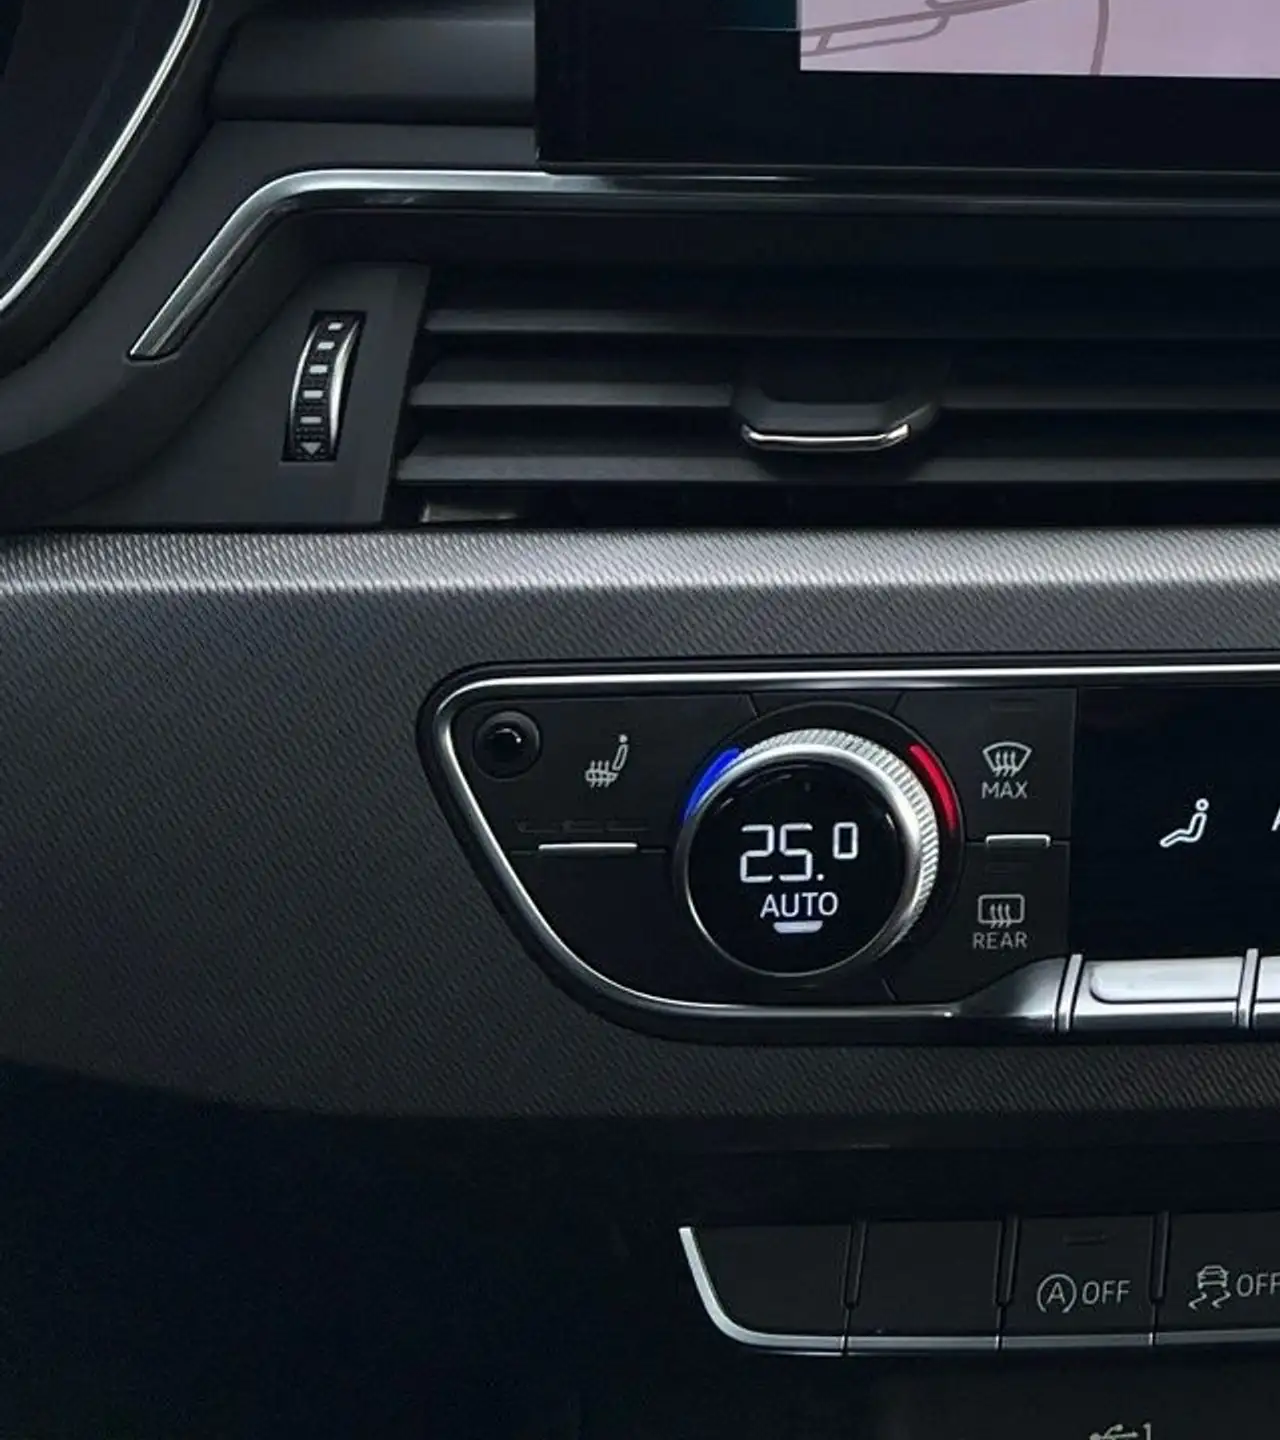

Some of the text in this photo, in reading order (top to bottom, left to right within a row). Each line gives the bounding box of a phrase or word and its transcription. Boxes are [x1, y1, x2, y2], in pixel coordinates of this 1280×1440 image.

[980, 781, 1028, 800] MAX
[739, 821, 859, 883] 25.0
[759, 891, 839, 919] AUTO
[971, 931, 1028, 951] REAR
[1082, 1280, 1131, 1306] OFF
